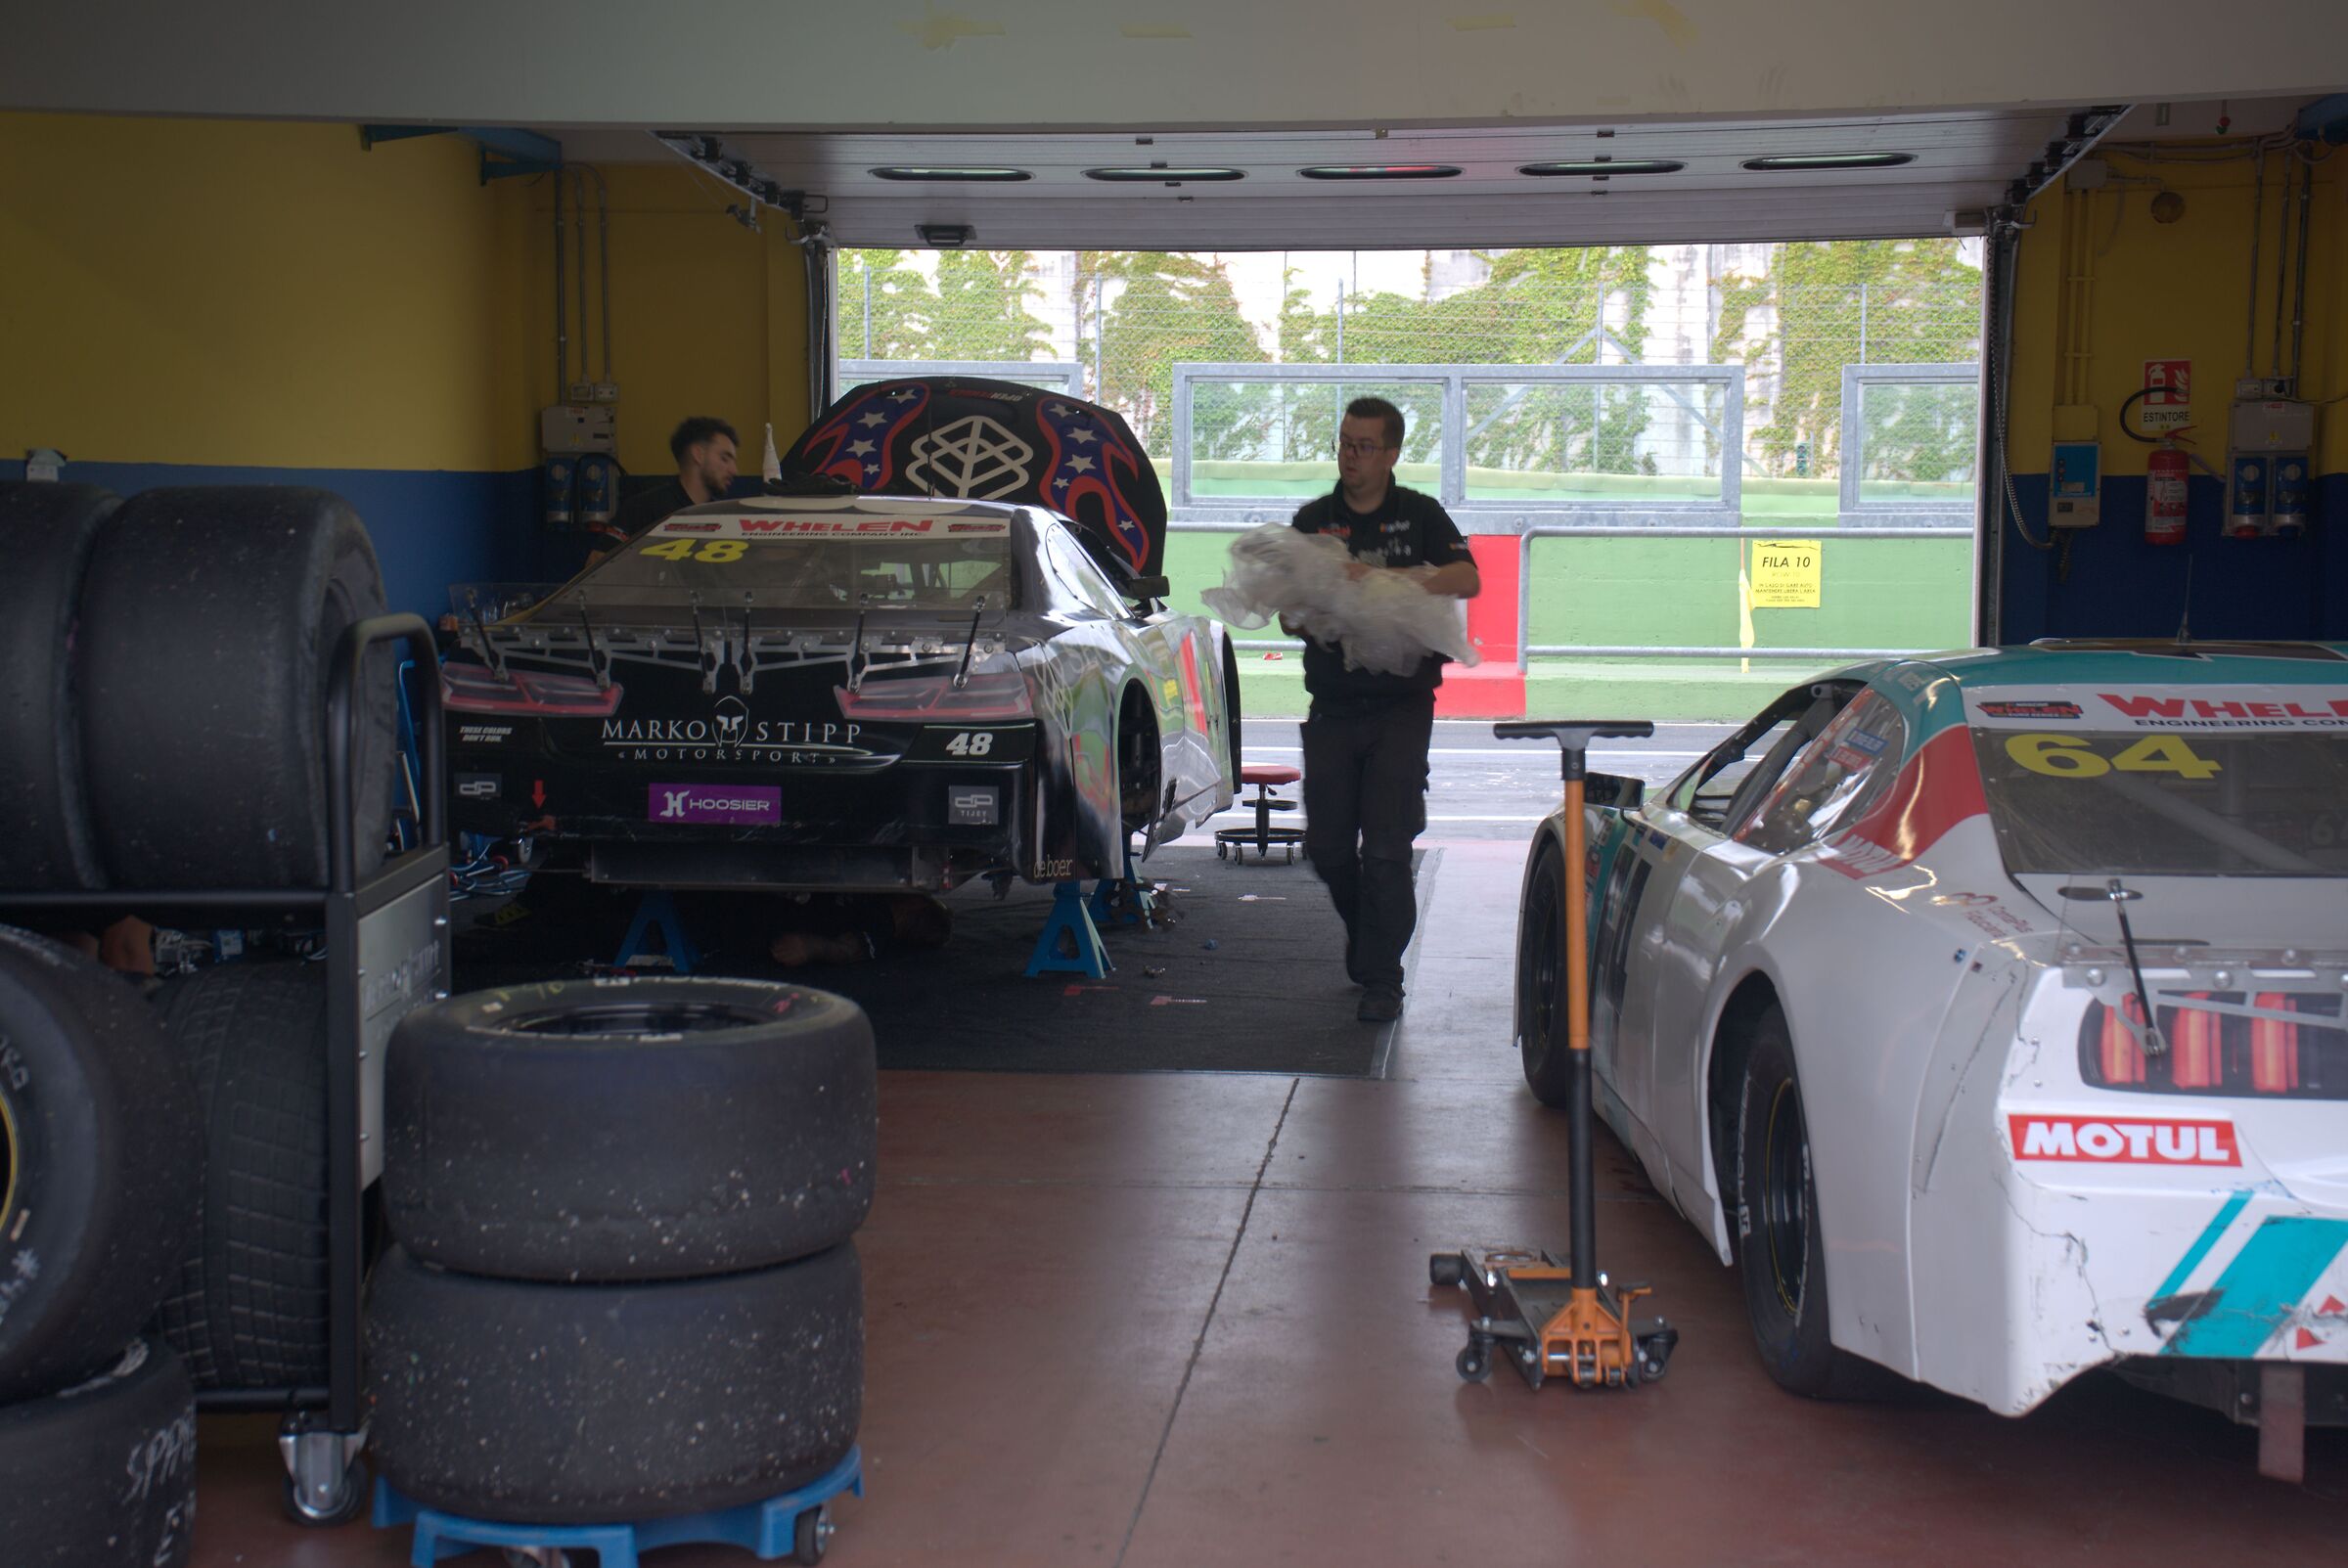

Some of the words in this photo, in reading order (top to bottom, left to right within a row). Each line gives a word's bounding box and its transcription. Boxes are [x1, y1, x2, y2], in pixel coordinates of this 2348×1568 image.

[2144, 411, 2190, 424] ESTINTORE
[739, 519, 933, 532] WHELEN
[639, 538, 749, 563] 48
[1762, 557, 1789, 567] FILA
[1796, 557, 1811, 567] 10
[602, 718, 707, 742] MARKO
[757, 722, 861, 743] STIPP
[945, 732, 992, 756] 48
[634, 748, 820, 764] MOTORSPORT
[2004, 733, 2222, 780] 64
[689, 797, 771, 812] HOOSIER
[2021, 1121, 2232, 1161] MOTUL
